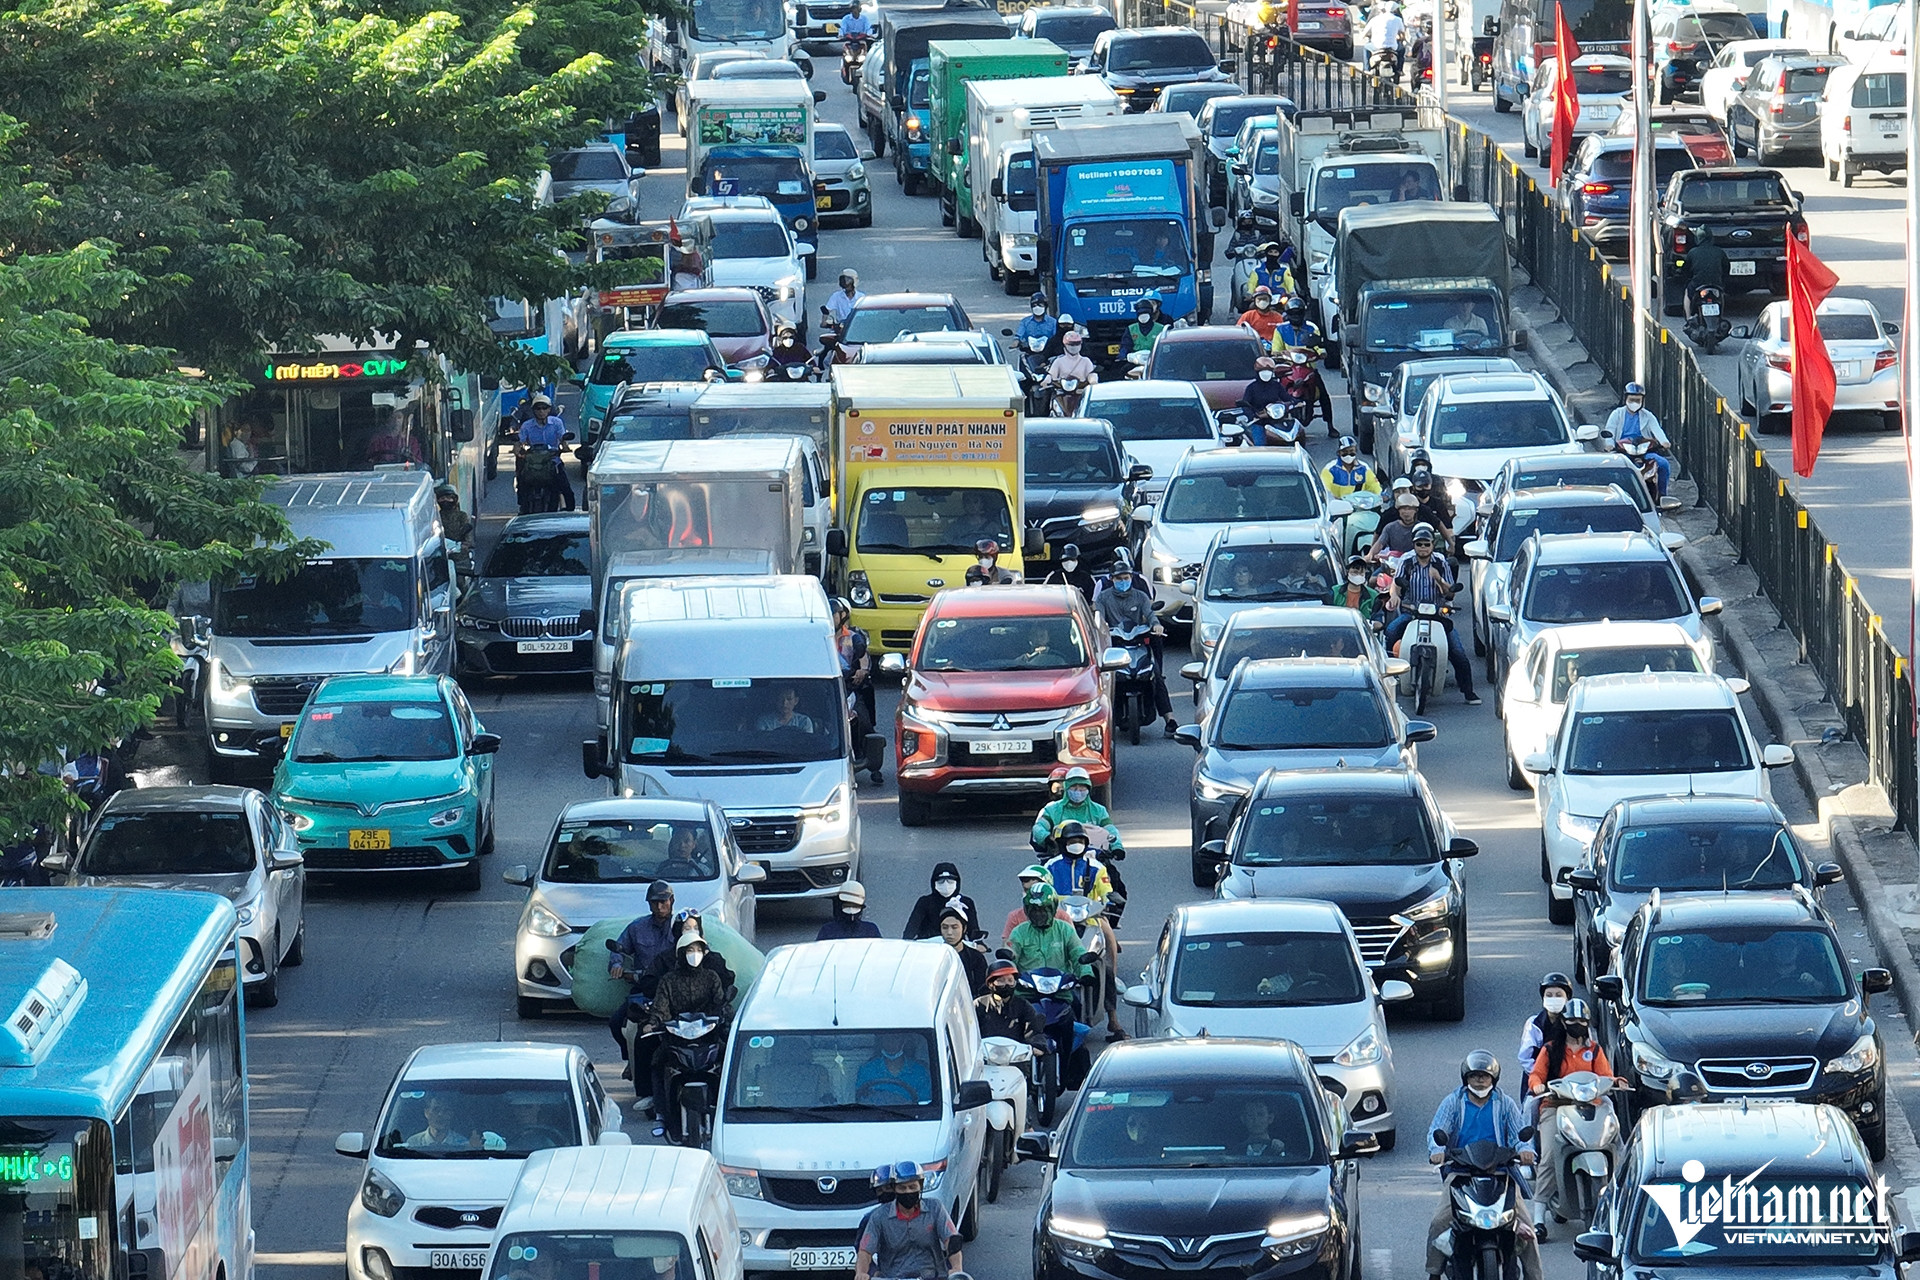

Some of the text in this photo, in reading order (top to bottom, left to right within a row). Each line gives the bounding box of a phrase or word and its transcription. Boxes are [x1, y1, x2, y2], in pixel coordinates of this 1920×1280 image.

[1111, 288, 1144, 297] ISUZU
[363, 360, 388, 376] CV
[889, 419, 1006, 436] CHUYỂN PHÁT NHANH
[894, 440, 916, 449] Thái
[918, 440, 958, 451] Nguyên
[968, 440, 982, 449] Hà
[975, 742, 1027, 752] 29K-172.32
[361, 831, 378, 839] 29E
[353, 841, 386, 849] 041.37
[461, 1213, 478, 1222] KIA
[434, 1253, 487, 1267] 30A-656
